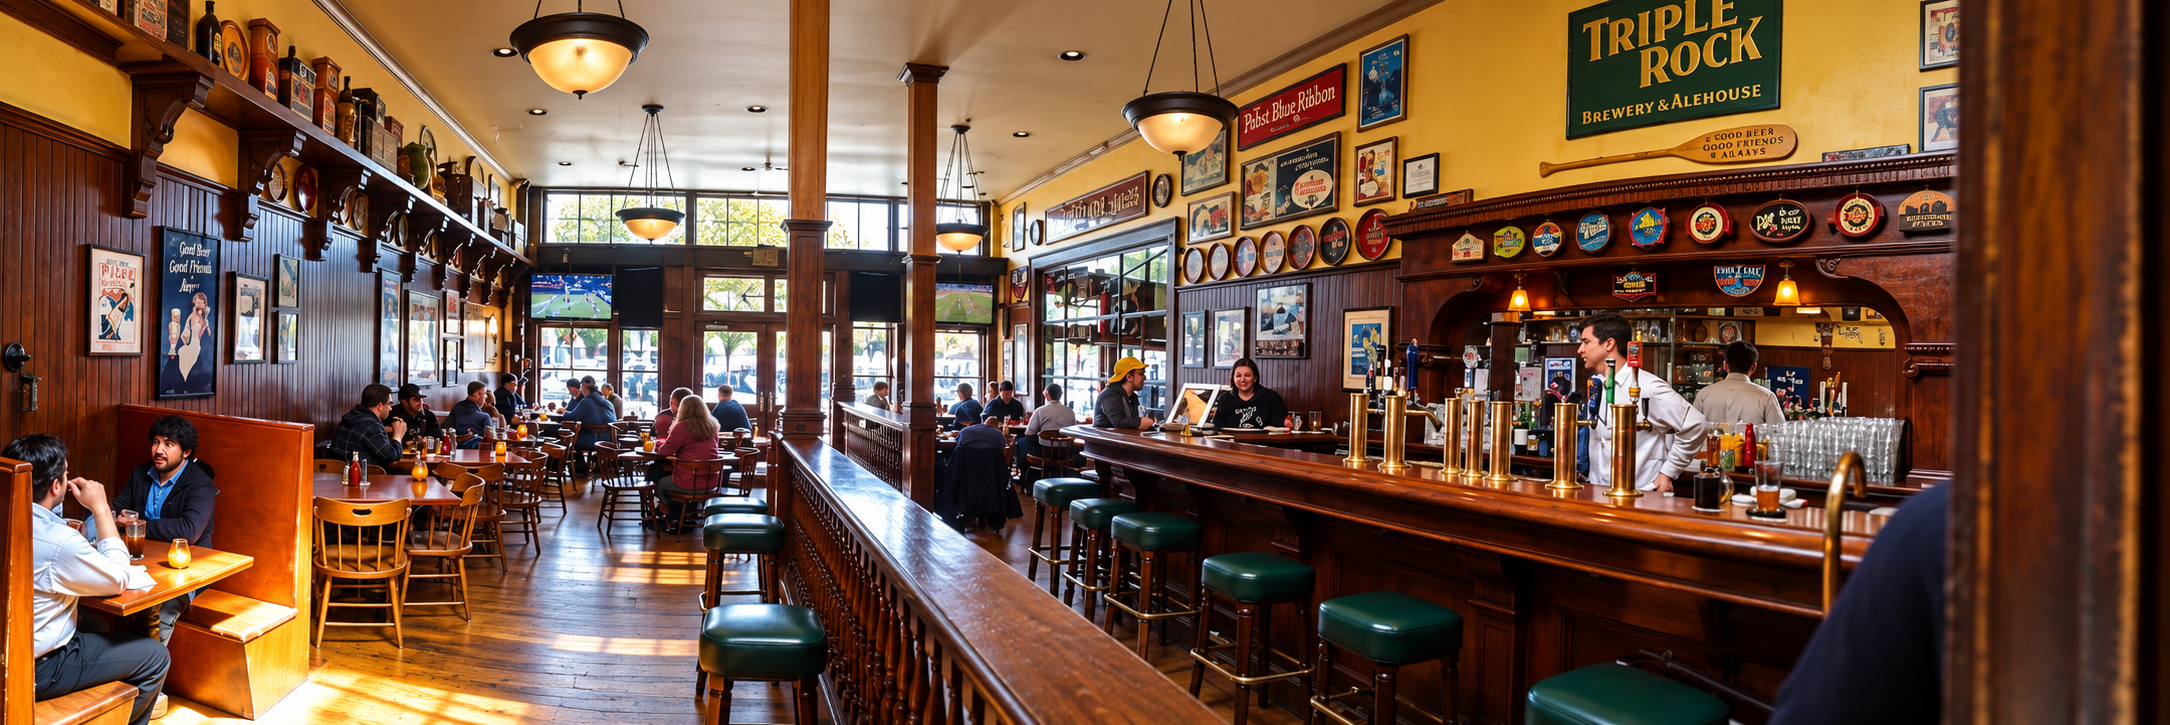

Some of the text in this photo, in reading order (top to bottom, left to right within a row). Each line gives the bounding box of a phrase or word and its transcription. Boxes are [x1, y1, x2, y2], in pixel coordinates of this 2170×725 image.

[1582, 0, 1738, 62] TRIPLE
[1639, 15, 1763, 88] ROCK
[1582, 84, 1761, 125] BREWERY & ALEHOUSE
